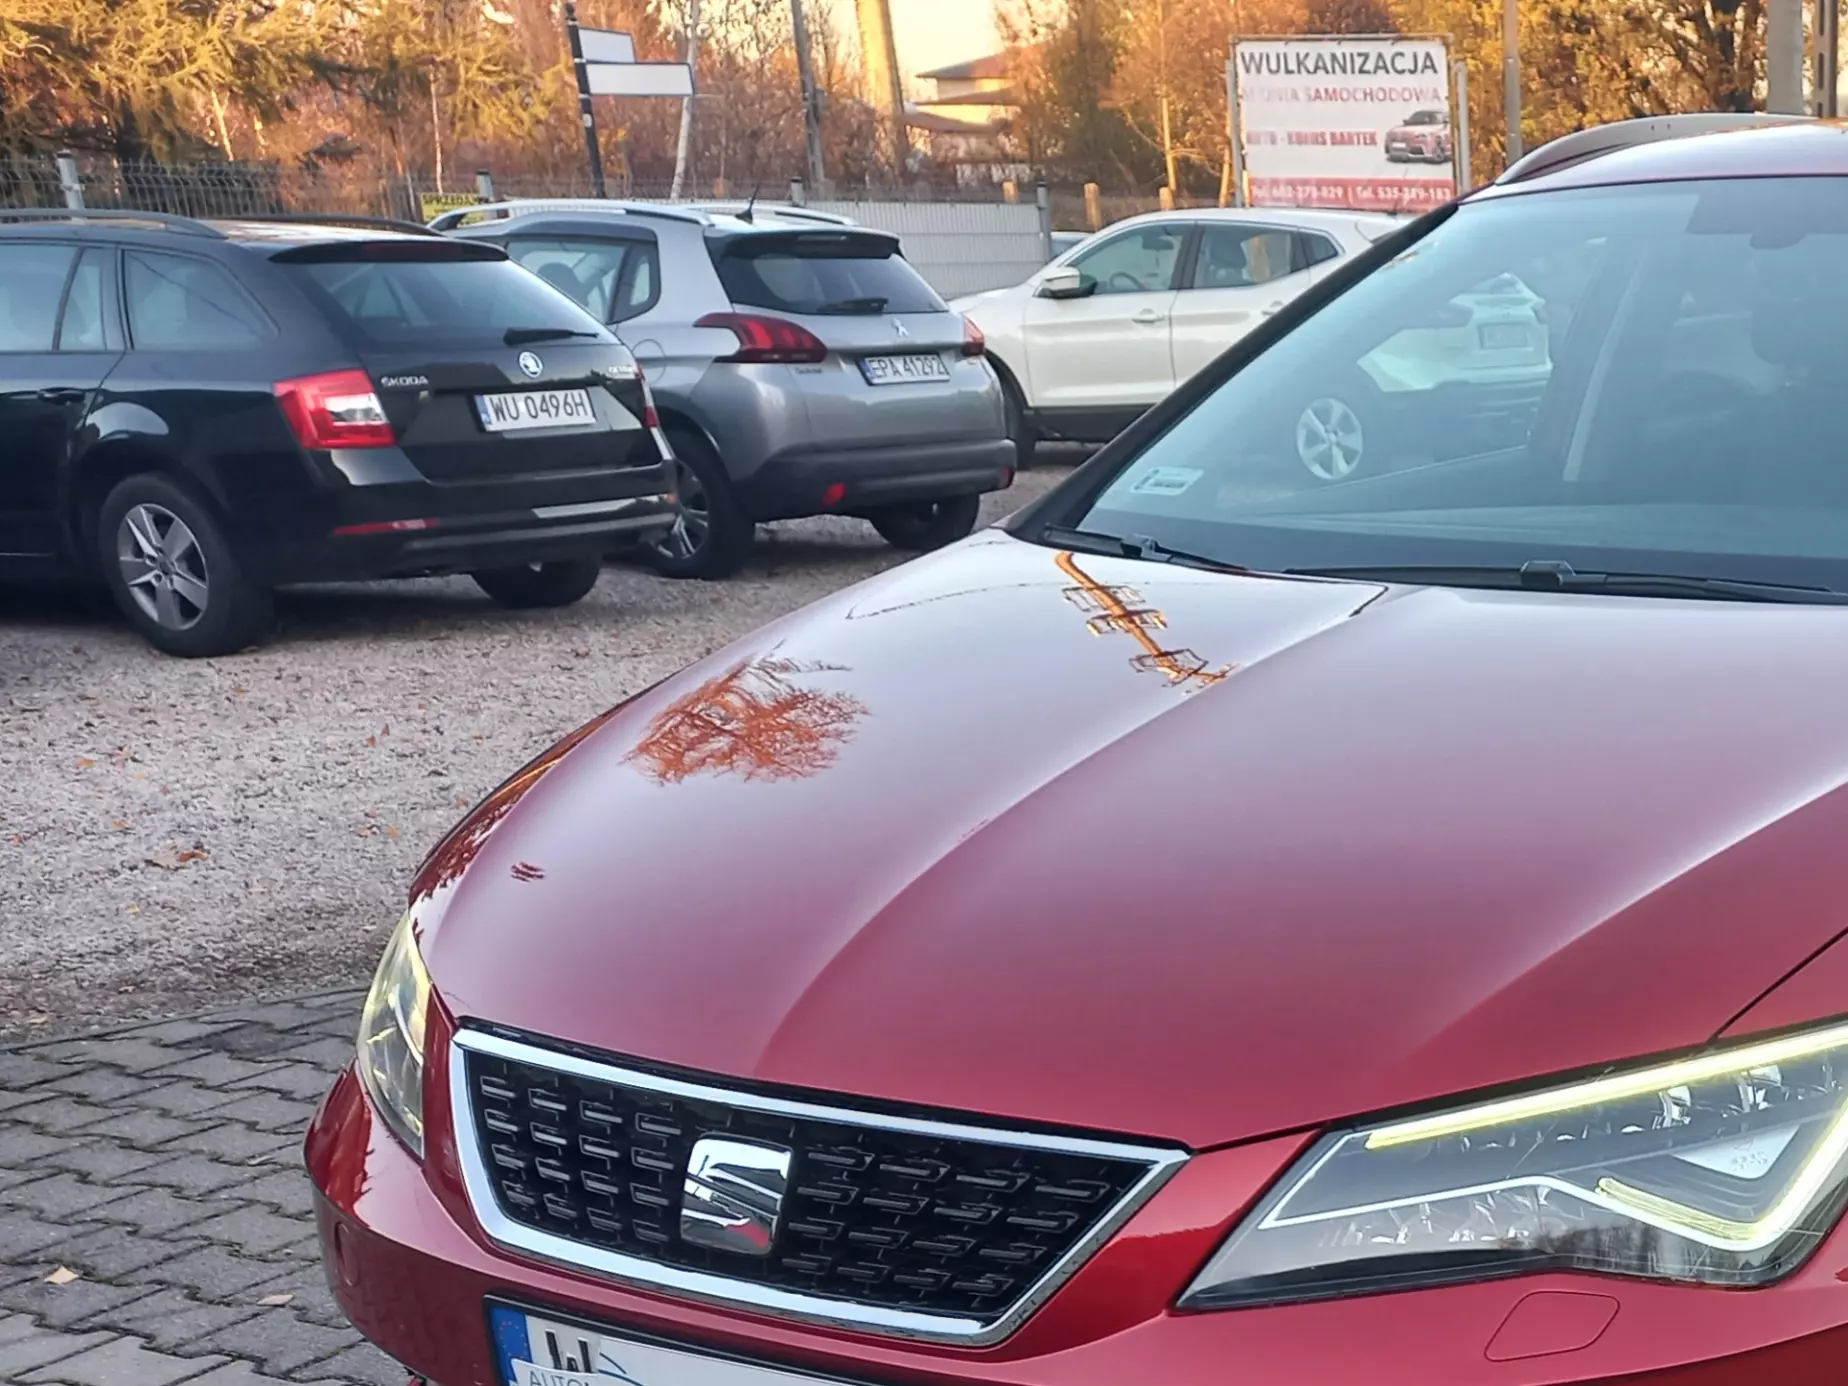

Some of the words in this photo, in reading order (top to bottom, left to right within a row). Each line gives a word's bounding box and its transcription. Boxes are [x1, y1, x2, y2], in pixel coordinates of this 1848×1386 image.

[1241, 51, 1438, 75] WULKANIZACJA
[1305, 87, 1442, 103] SAMOCHODOWA
[868, 358, 902, 378] EPA
[903, 357, 949, 376] 41292
[491, 393, 520, 422] WU
[525, 393, 588, 421] 0496H
